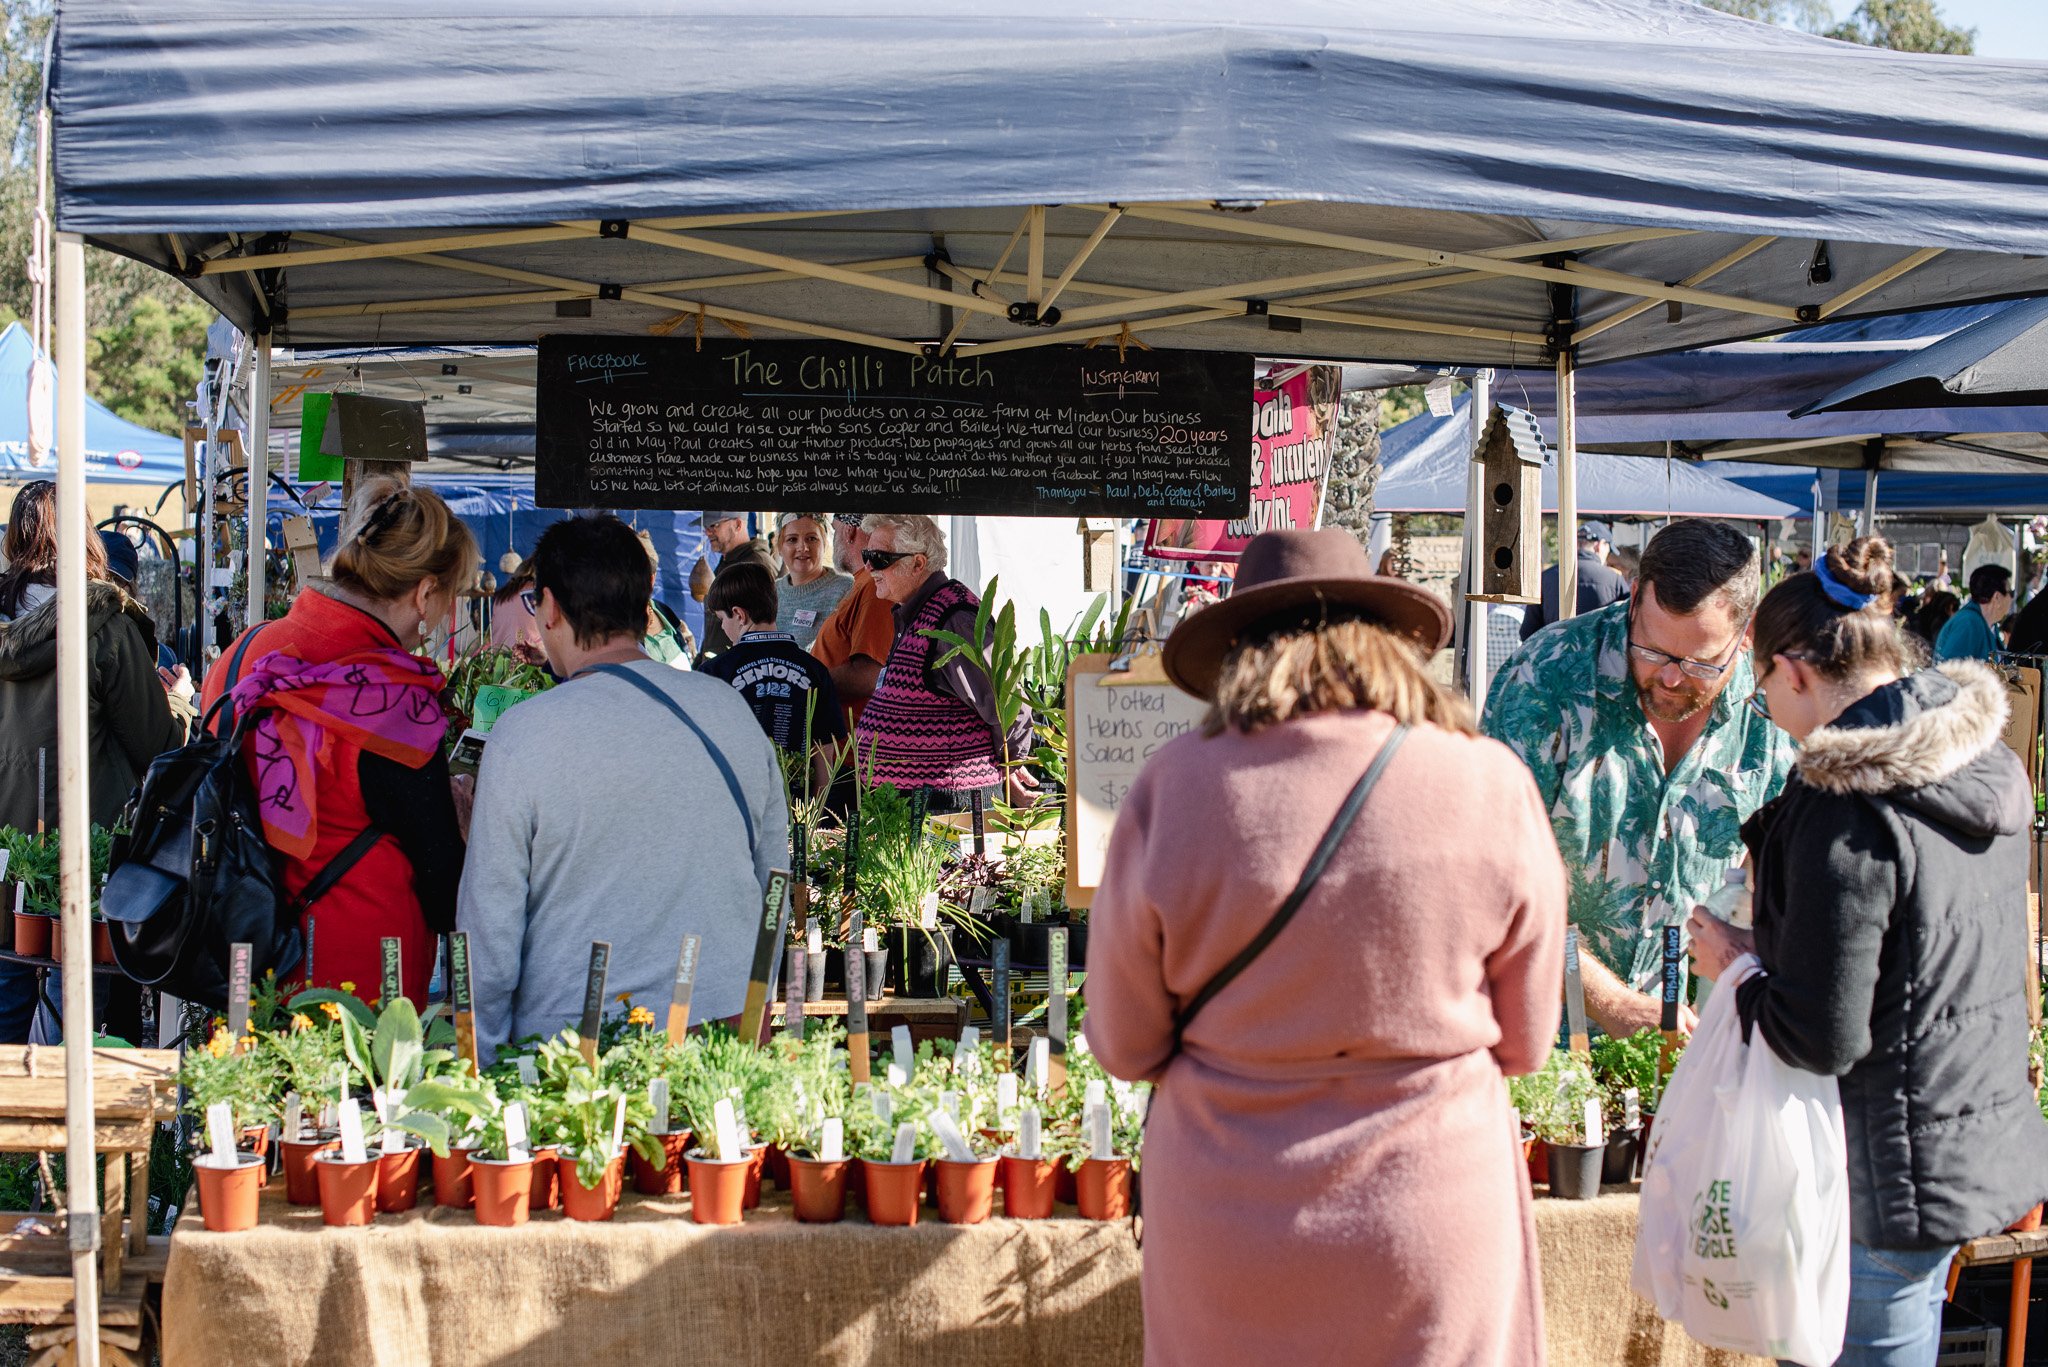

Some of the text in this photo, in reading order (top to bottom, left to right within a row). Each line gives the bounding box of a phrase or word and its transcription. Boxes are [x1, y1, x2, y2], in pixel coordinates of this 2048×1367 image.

[568, 353, 647, 372] FACEBOOK
[722, 350, 994, 390] The Chilli Patch
[588, 398, 617, 417] We
[620, 403, 659, 423] grow
[666, 402, 695, 418] and
[701, 403, 754, 419] create
[762, 406, 780, 420] all
[788, 408, 816, 421] our
[820, 404, 885, 426] products
[889, 408, 909, 420] on
[914, 407, 926, 419] a
[931, 405, 948, 419] 2
[952, 407, 989, 419] acre
[992, 402, 1030, 422] farm
[1035, 407, 1052, 419] at
[1111, 408, 1139, 424] Our
[1142, 408, 1202, 425] business
[593, 418, 642, 434] Started
[646, 420, 663, 432] so
[693, 421, 729, 434] could
[736, 422, 774, 435] raise
[778, 425, 803, 436] our
[806, 423, 832, 435] two
[838, 422, 872, 435] sons
[879, 422, 919, 440] Cooper
[925, 422, 953, 434] and
[1006, 422, 1029, 436] We
[1029, 423, 1073, 436] turned
[1078, 423, 1102, 438] (our
[1107, 424, 1159, 443] business)
[1159, 425, 1188, 445] 20
[1190, 430, 1228, 447] years
[589, 436, 614, 449] old
[618, 436, 630, 449] in
[673, 436, 701, 450] Paul
[708, 437, 754, 449] creates
[759, 437, 774, 449] all
[777, 439, 799, 449] our
[802, 436, 847, 449] timber
[910, 437, 931, 448] Deb
[999, 438, 1021, 449] and
[1025, 439, 1057, 454] grows
[1059, 438, 1073, 449] all
[1077, 442, 1098, 450] our
[1101, 440, 1132, 451] herbs
[1135, 442, 1161, 455] from
[656, 451, 686, 464] have
[689, 453, 724, 464] made
[727, 454, 746, 463] our
[749, 451, 799, 463] business
[804, 451, 832, 461] what
[835, 451, 846, 461] it
[849, 450, 861, 461] is
[905, 451, 923, 462] We
[971, 450, 986, 461] do
[987, 451, 1008, 462] this
[1012, 453, 1052, 463] without
[1057, 455, 1077, 468] you
[1101, 454, 1112, 467] If
[1114, 455, 1136, 468] you
[1142, 453, 1171, 464] have
[1176, 456, 1231, 468] purchased
[757, 466, 784, 482] hope
[786, 469, 808, 482] you
[814, 465, 842, 478] love
[847, 466, 879, 479] what
[1010, 469, 1032, 478] are
[1032, 469, 1048, 478] on
[1106, 470, 1128, 481] and
[1189, 469, 1222, 482] Follow
[633, 480, 661, 492] have
[664, 480, 684, 491] lots
[687, 481, 702, 495] of
[756, 482, 779, 493] Our
[782, 483, 807, 496] posts
[809, 481, 849, 495] always
[892, 484, 905, 493] us
[911, 483, 942, 494] smile
[1036, 486, 1086, 504] Thankyou
[1203, 484, 1236, 502] Bailey
[1147, 497, 1165, 507] and
[736, 661, 757, 674] CHAPEL
[770, 657, 785, 665] STATE
[786, 660, 807, 674] SCHOOL
[731, 663, 812, 692] SENIORS
[1107, 687, 1165, 713] Potted
[1087, 714, 1143, 739] Herbs
[1080, 743, 1134, 764] Salad
[1050, 932, 1067, 995] dandelion
[1664, 928, 1679, 1003] curly parsley
[846, 948, 863, 1003] oregano
